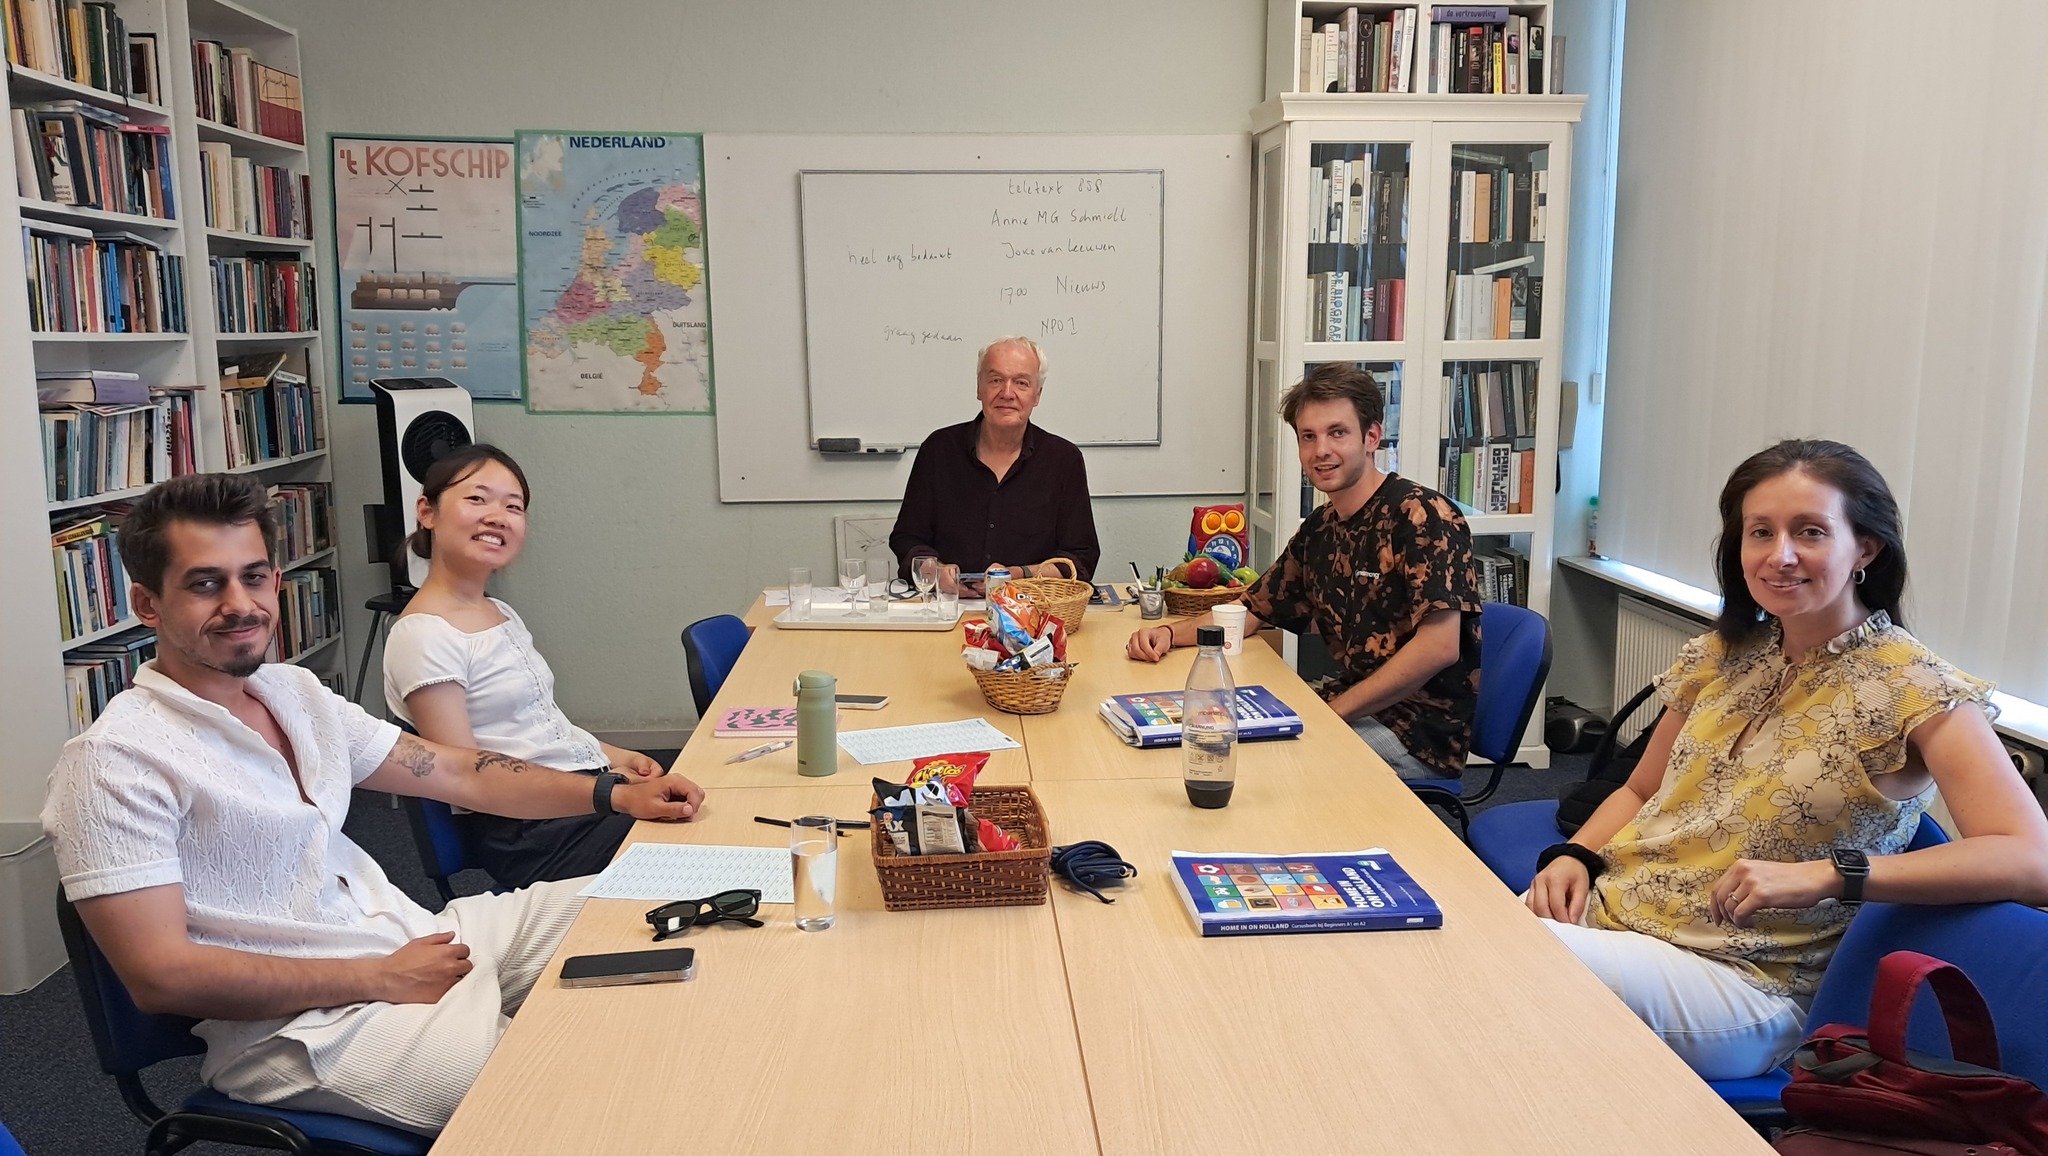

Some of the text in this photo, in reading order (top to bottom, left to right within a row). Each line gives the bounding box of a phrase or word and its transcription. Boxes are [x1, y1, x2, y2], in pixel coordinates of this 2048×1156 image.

[569, 136, 666, 148] NEDERLAND
[365, 146, 510, 179] KOFSCHIP
[1008, 177, 1064, 195] teletext
[991, 208, 1029, 226] Annie
[1037, 210, 1060, 224] MG
[1040, 246, 1063, 255] van
[886, 254, 904, 271] erg
[1056, 275, 1106, 294] Nieuws
[1334, 289, 1343, 342] BIOGRAFI
[1040, 318, 1064, 337] NPO
[1499, 447, 1510, 512] PAUL VAN
[1341, 867, 1377, 895] HOLLAND
[1343, 886, 1370, 908] HOME
[1366, 895, 1385, 908] ON
